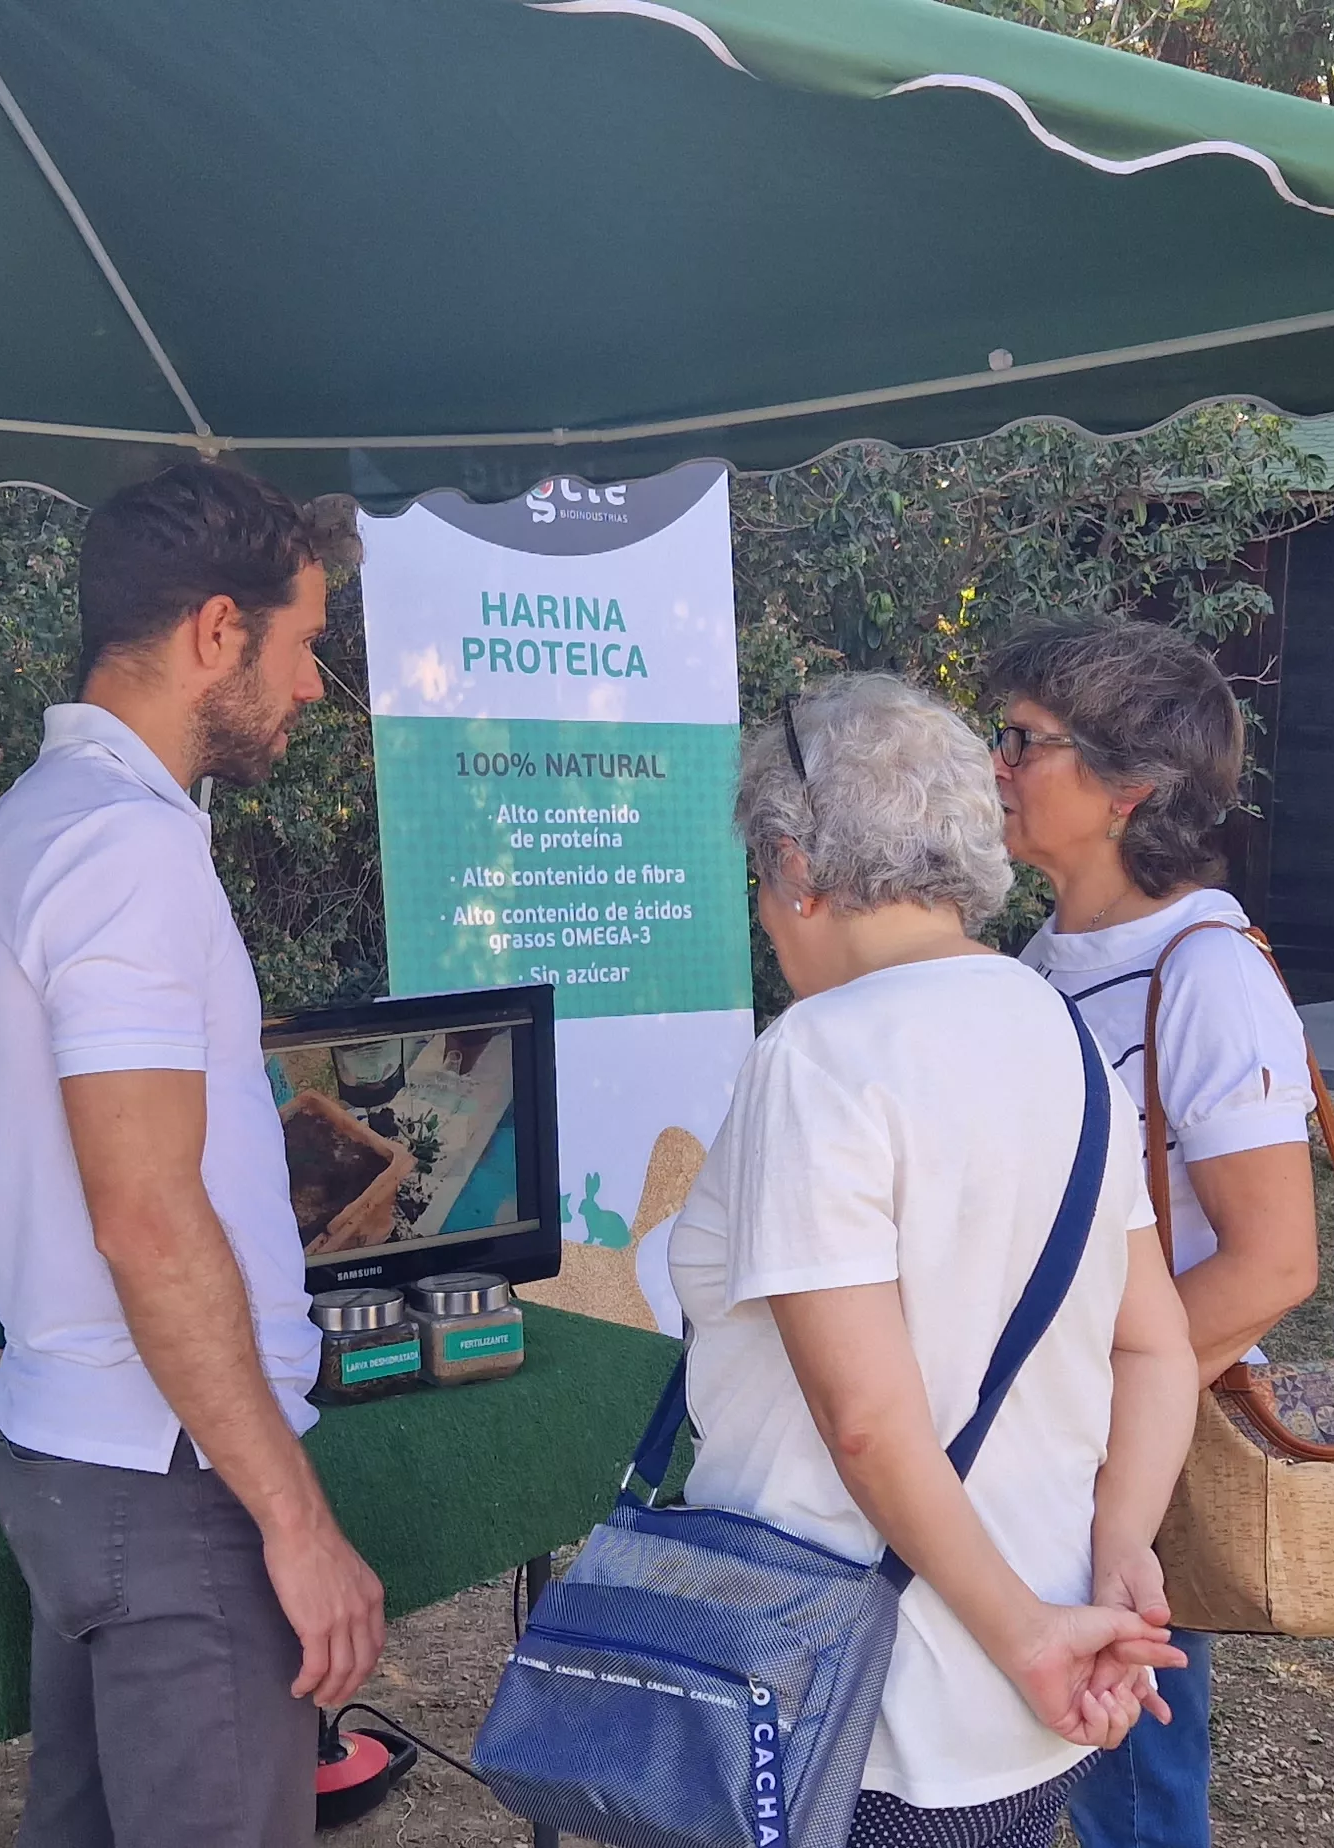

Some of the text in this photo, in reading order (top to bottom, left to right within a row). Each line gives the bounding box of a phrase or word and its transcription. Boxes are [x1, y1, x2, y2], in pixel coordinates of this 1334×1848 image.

[559, 508, 629, 524] BIOINDUSTRIAS
[481, 591, 627, 633] HARINA
[462, 637, 648, 679] PROTEICA
[455, 751, 667, 779] 100% NATURAL
[497, 803, 640, 825] Alto contenido
[510, 827, 623, 852] de proteína
[462, 864, 686, 888] Alto contenido de fibra
[452, 899, 693, 927] Alto contenido de ácidos
[489, 926, 651, 955] grasos OMEGA-3
[529, 961, 631, 985] Sin azúcar
[459, 1333, 509, 1350] FERTILIZANTE
[753, 1723, 780, 1847] CACHA
